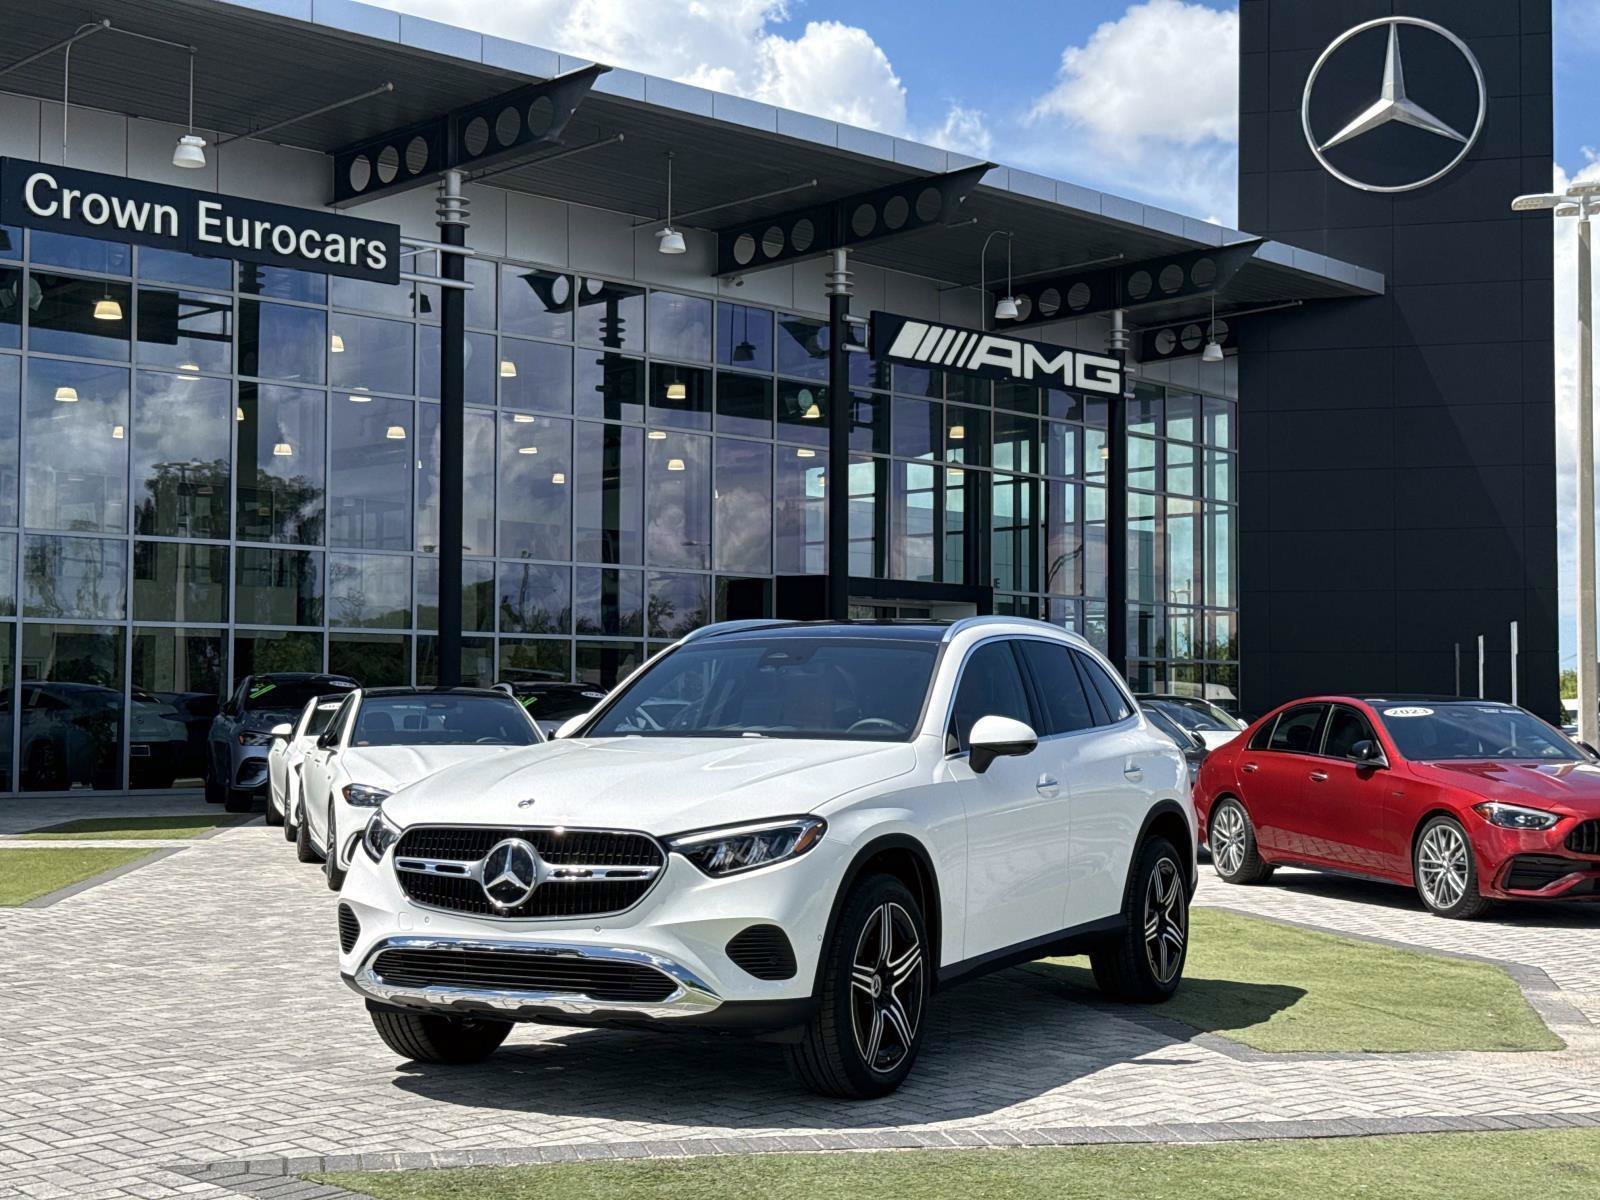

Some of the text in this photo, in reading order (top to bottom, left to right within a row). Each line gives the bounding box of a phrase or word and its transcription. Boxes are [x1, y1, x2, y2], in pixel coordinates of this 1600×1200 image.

[24, 172, 388, 270] Crown Eurocars
[966, 335, 1121, 395] AMG
